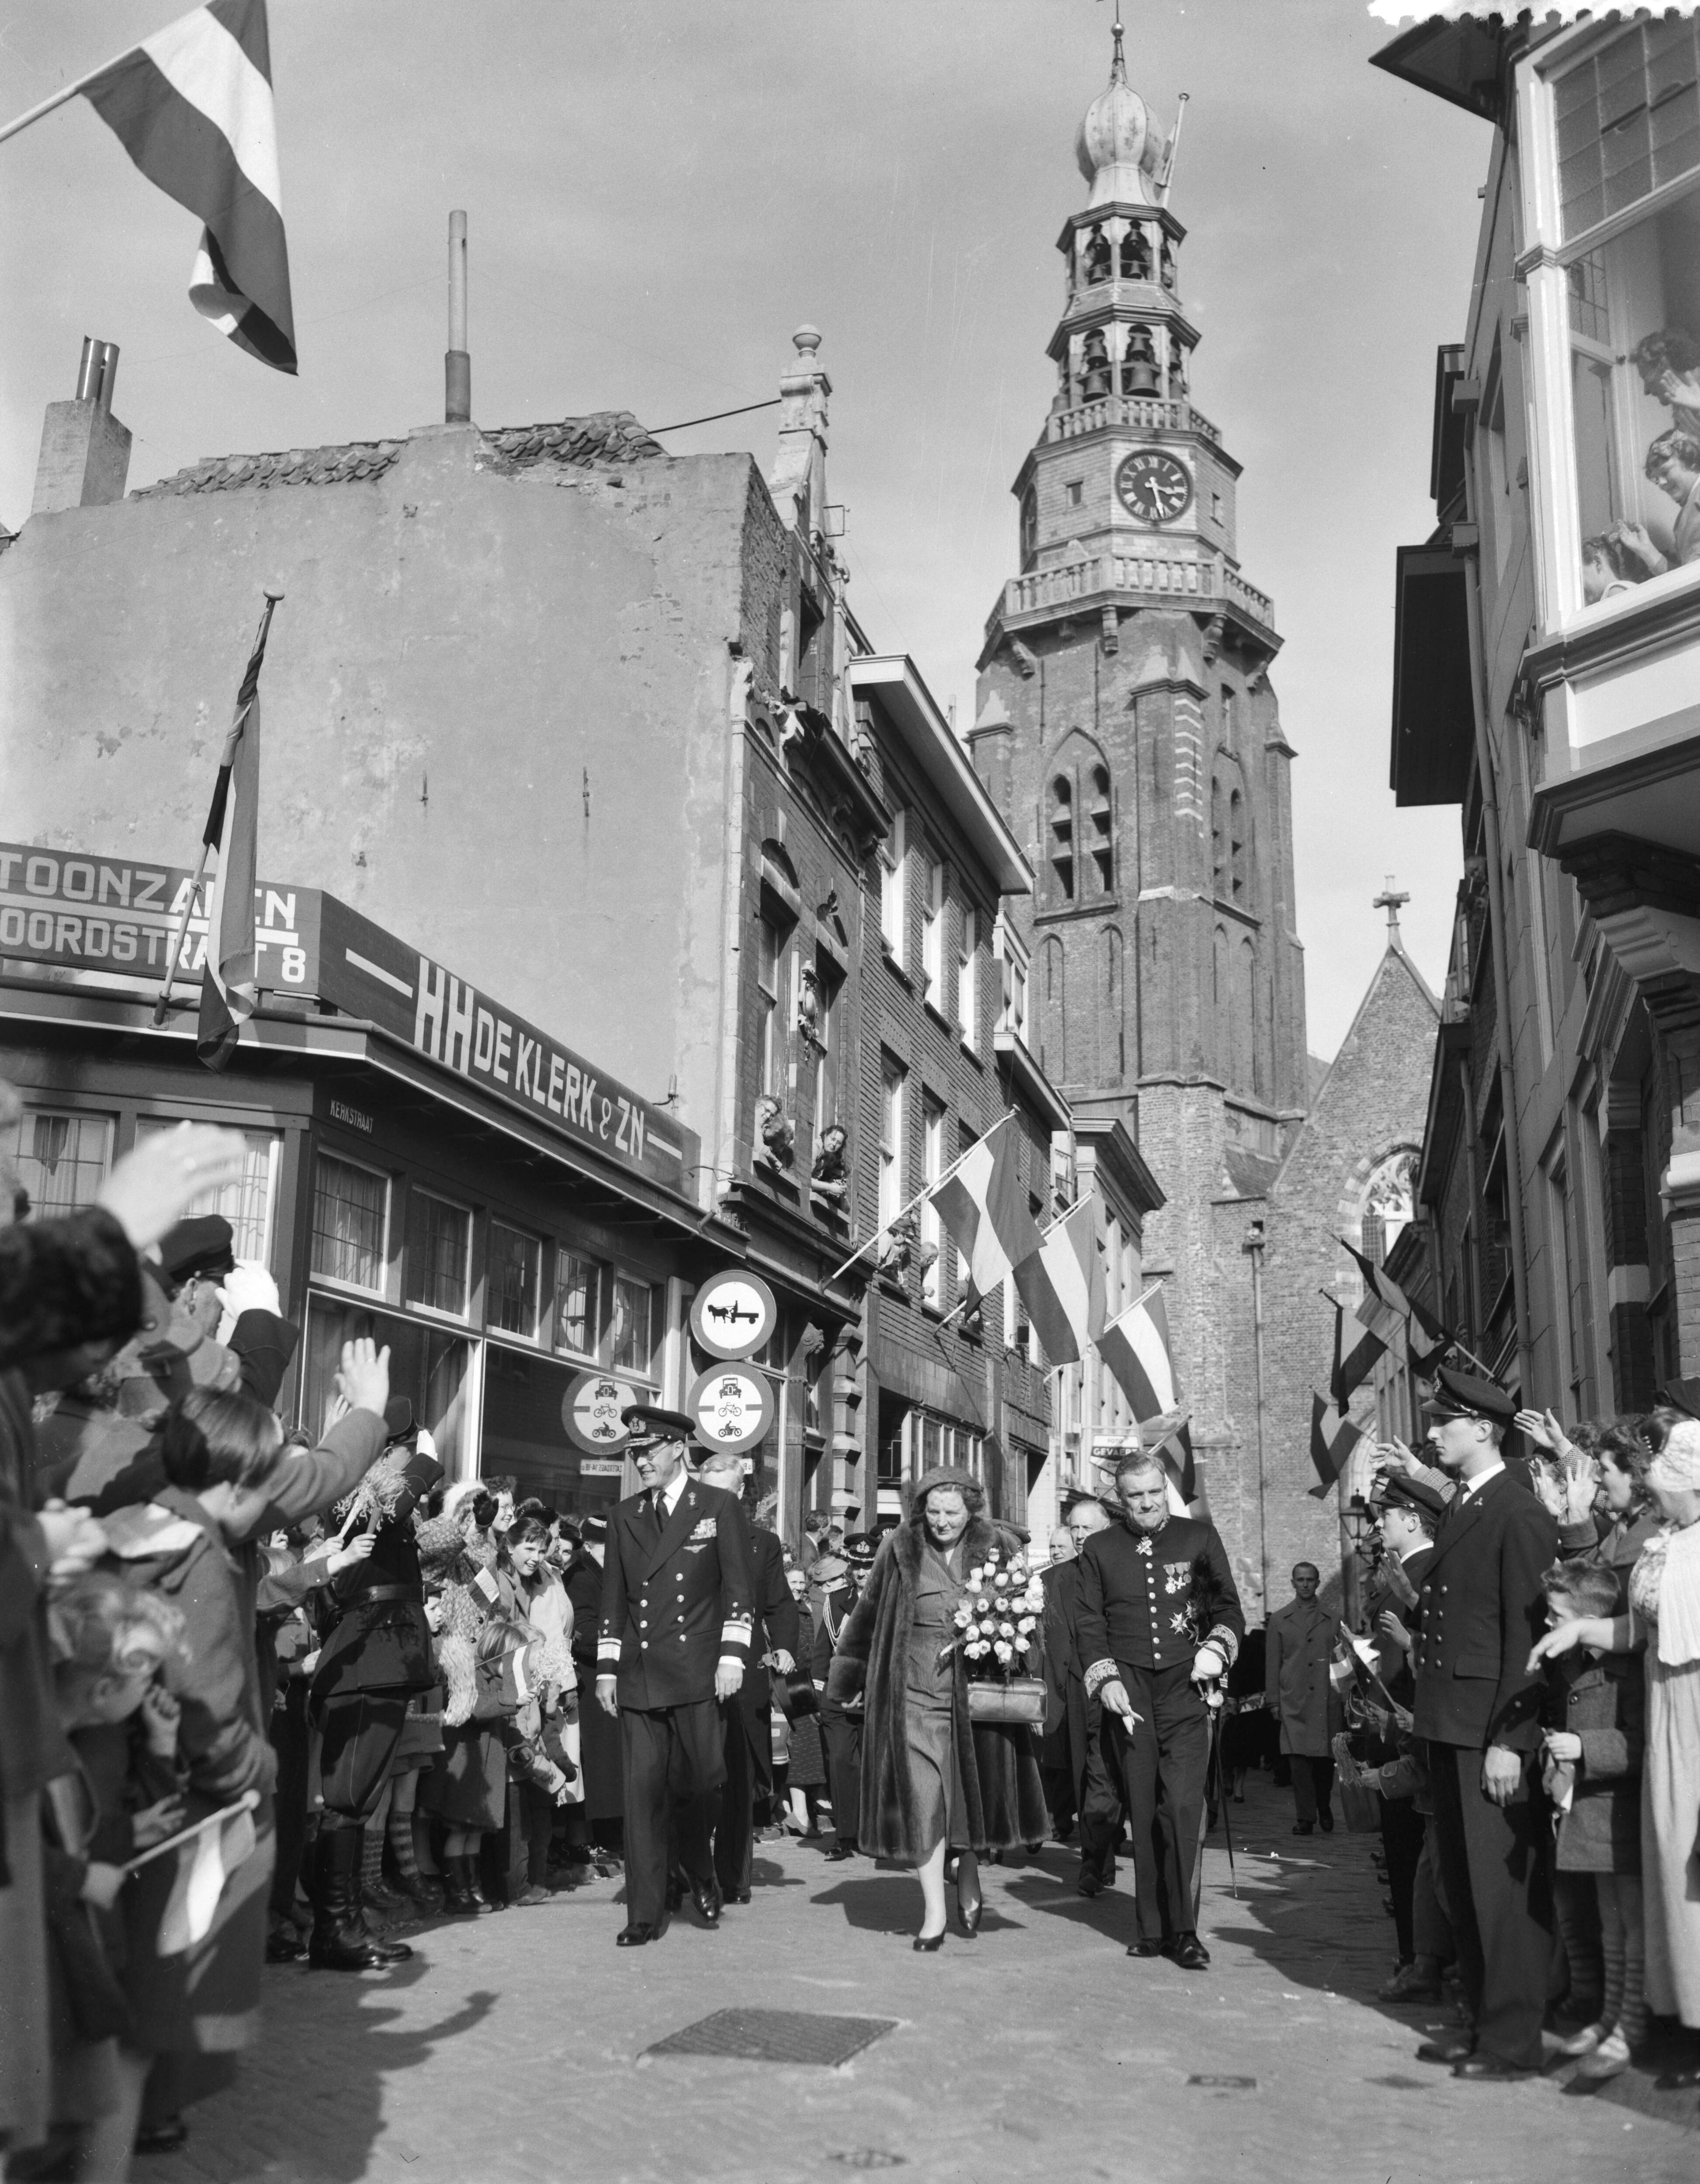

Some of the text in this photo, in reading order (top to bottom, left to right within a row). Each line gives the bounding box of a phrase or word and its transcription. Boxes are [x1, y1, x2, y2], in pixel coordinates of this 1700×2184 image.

[0, 852, 296, 929] TOONZAN
[1, 908, 306, 983] OORDSTRAT 8
[330, 1099, 374, 1133] KERKSTRAAT
[474, 1006, 512, 1084] DE
[515, 1032, 597, 1133] KLERK
[615, 1095, 644, 1161] ZN
